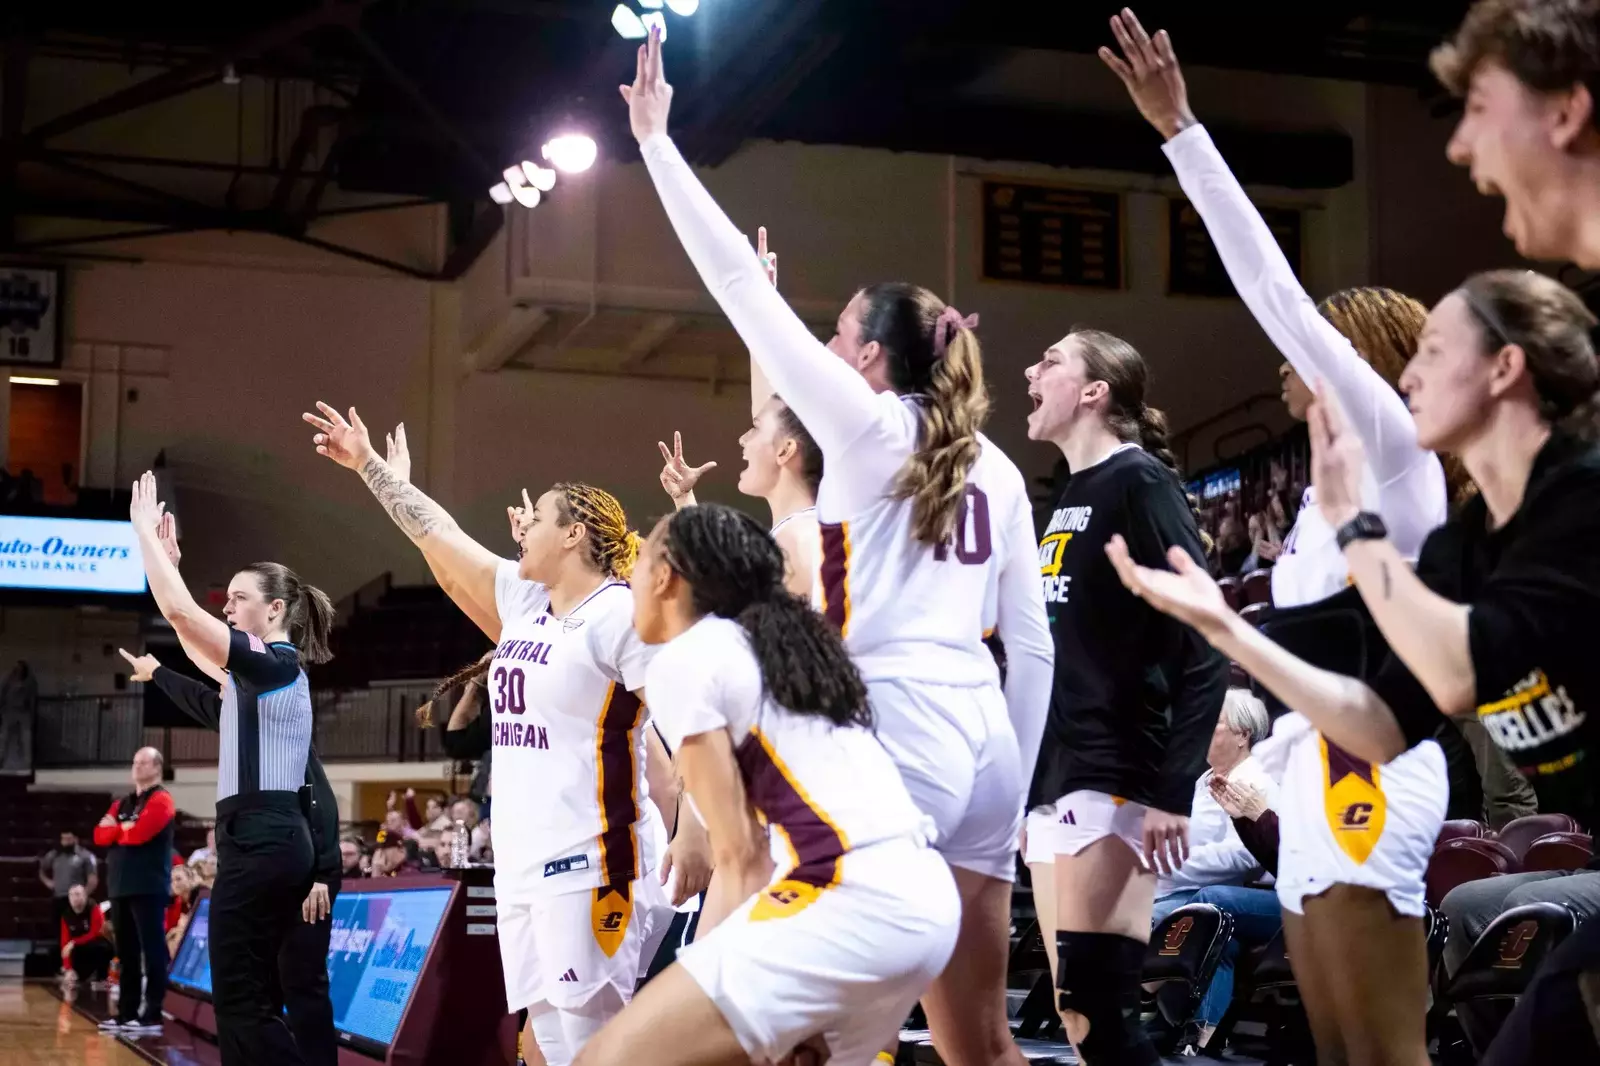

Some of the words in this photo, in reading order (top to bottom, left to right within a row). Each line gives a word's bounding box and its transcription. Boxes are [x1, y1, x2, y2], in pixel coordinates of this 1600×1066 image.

[493, 666, 526, 715] 30
[1340, 802, 1373, 827] C
[601, 911, 624, 931] C
